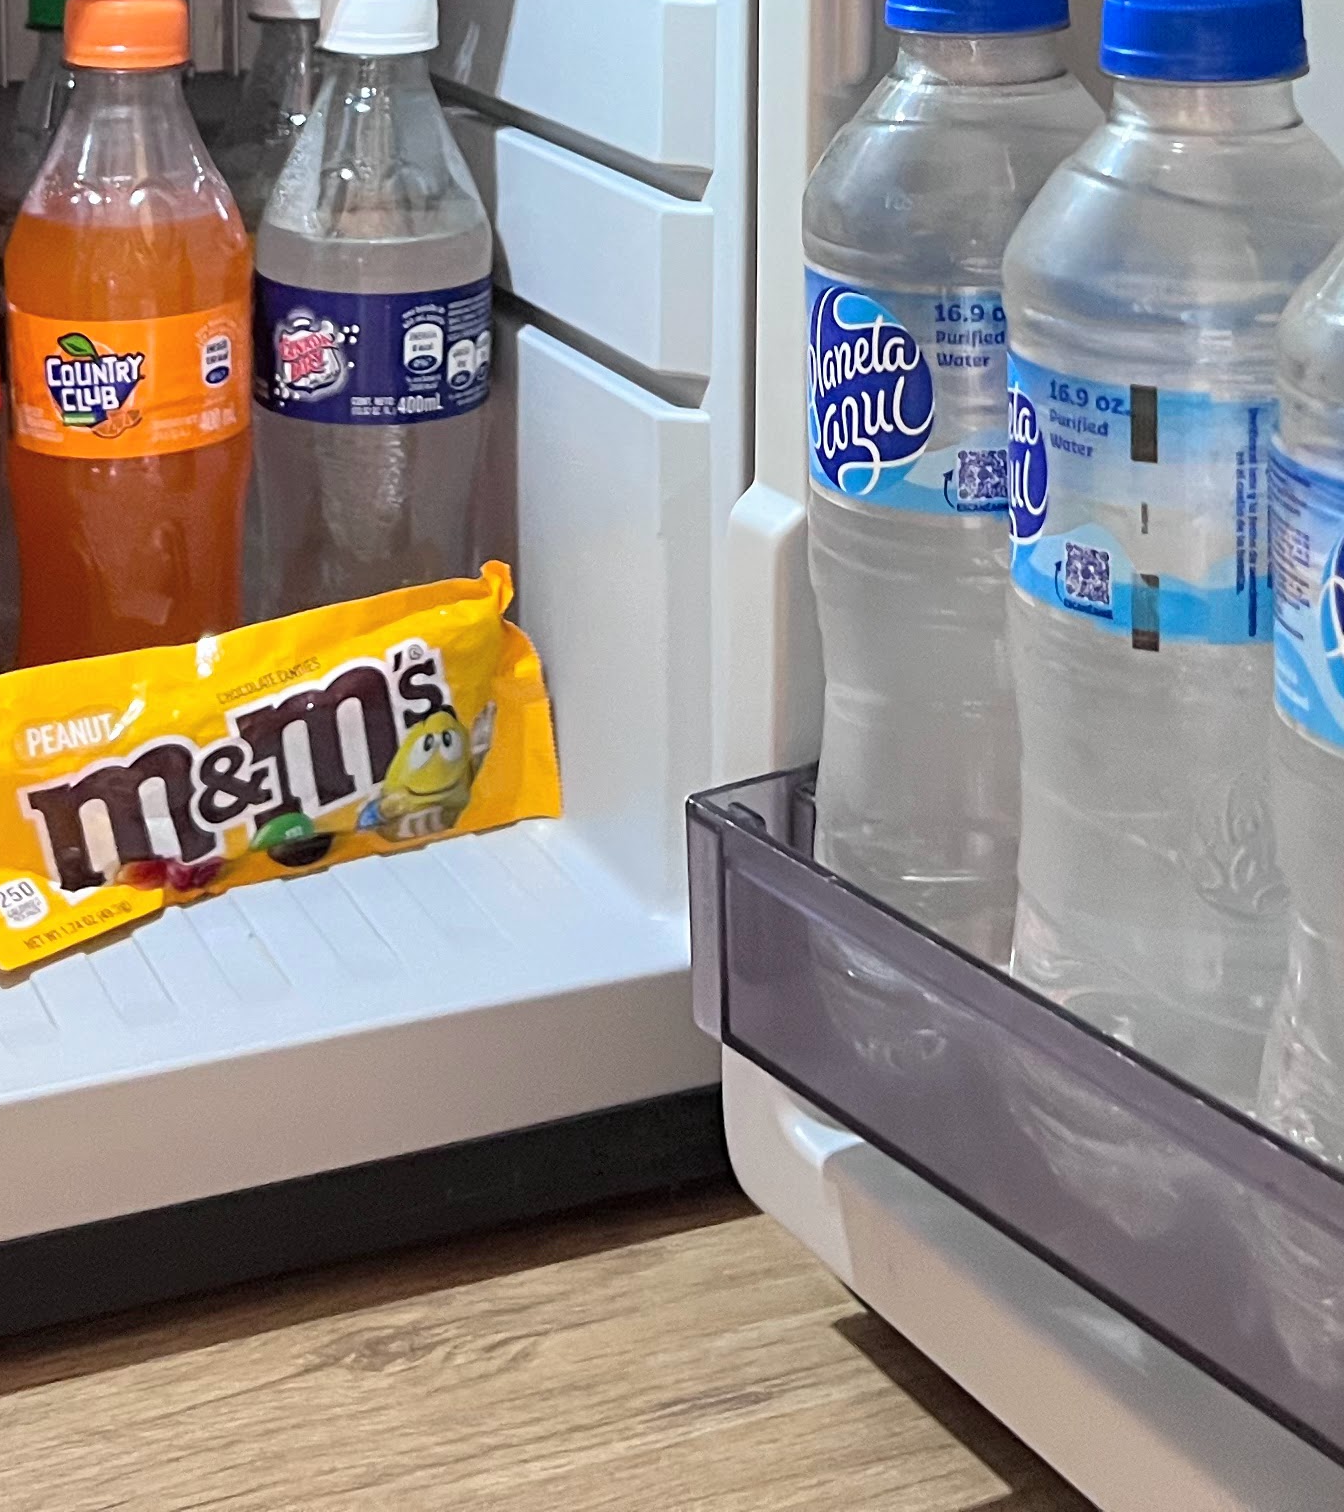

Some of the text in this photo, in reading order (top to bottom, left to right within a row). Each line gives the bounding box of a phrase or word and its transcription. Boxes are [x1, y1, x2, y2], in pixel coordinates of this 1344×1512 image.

[935, 304, 985, 322] 16.9
[936, 330, 1005, 348] Purified
[46, 355, 144, 388] COUNTRY
[937, 353, 990, 367] Water
[62, 386, 120, 412] CLUB
[1048, 379, 1088, 407] 16.9
[1049, 408, 1109, 436] Purified
[1050, 433, 1093, 457] Water
[27, 715, 114, 756] PEANUT
